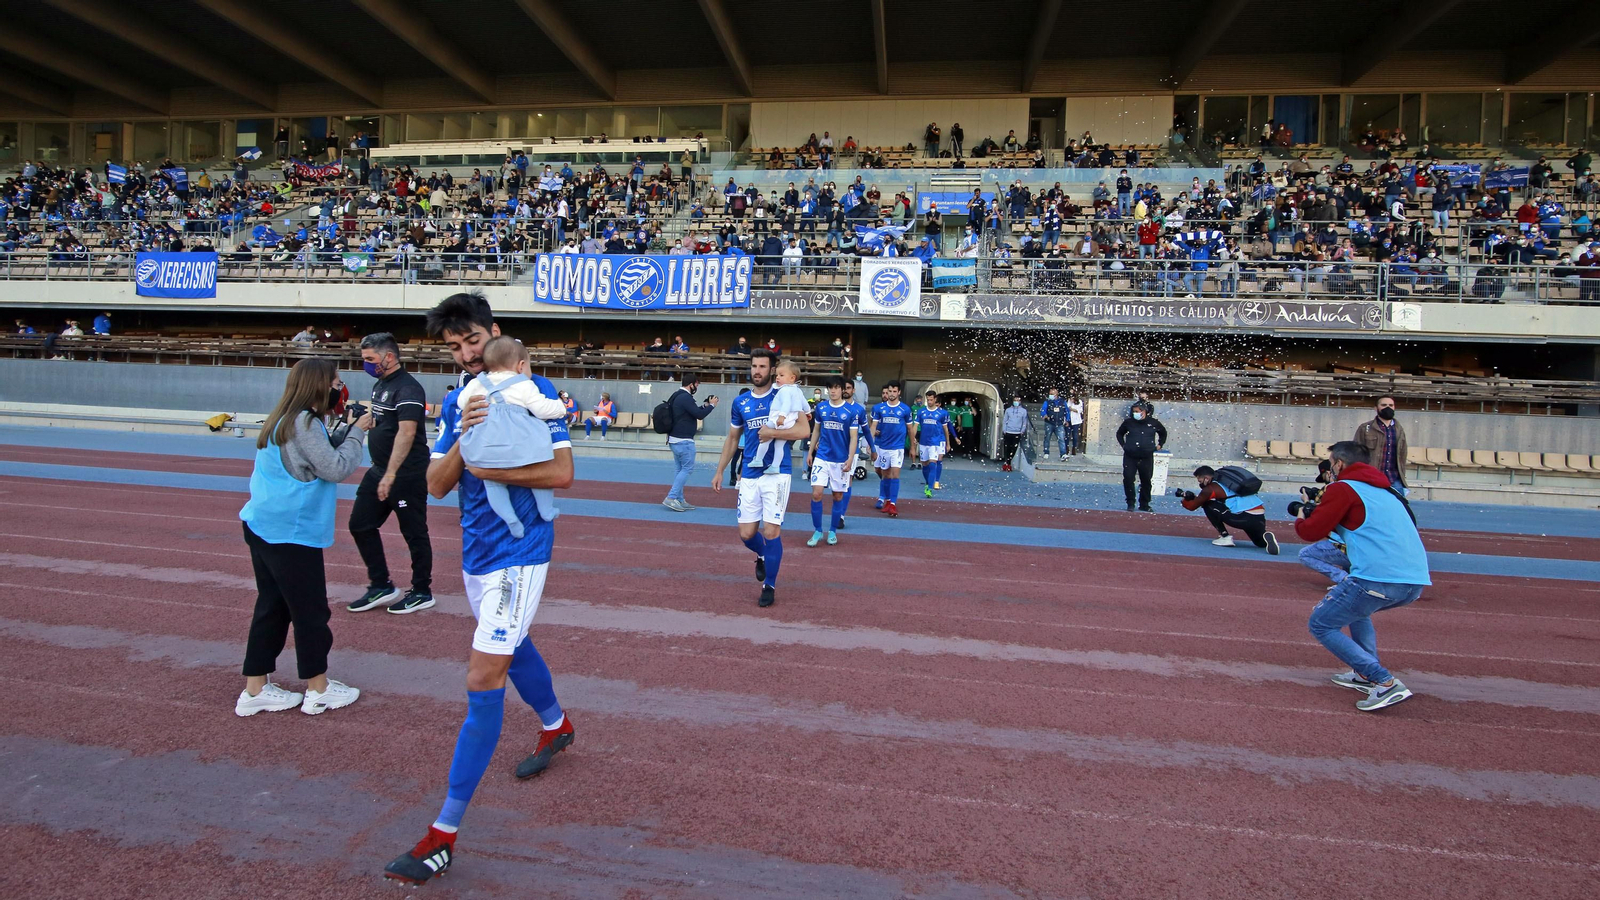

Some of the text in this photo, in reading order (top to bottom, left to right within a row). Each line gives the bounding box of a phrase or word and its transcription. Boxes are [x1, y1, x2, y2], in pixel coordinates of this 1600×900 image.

[157, 261, 217, 289] XERECISMO
[536, 254, 751, 305] SOMOS LIBRES
[626, 268, 652, 295] XEREZ
[760, 298, 807, 310] CALIDAD
[971, 299, 1041, 318] Andalucía
[1083, 303, 1227, 319] ALIMENTOS DE CALIDA
[1275, 302, 1357, 325] Andalucía
[812, 465, 823, 475] 27
